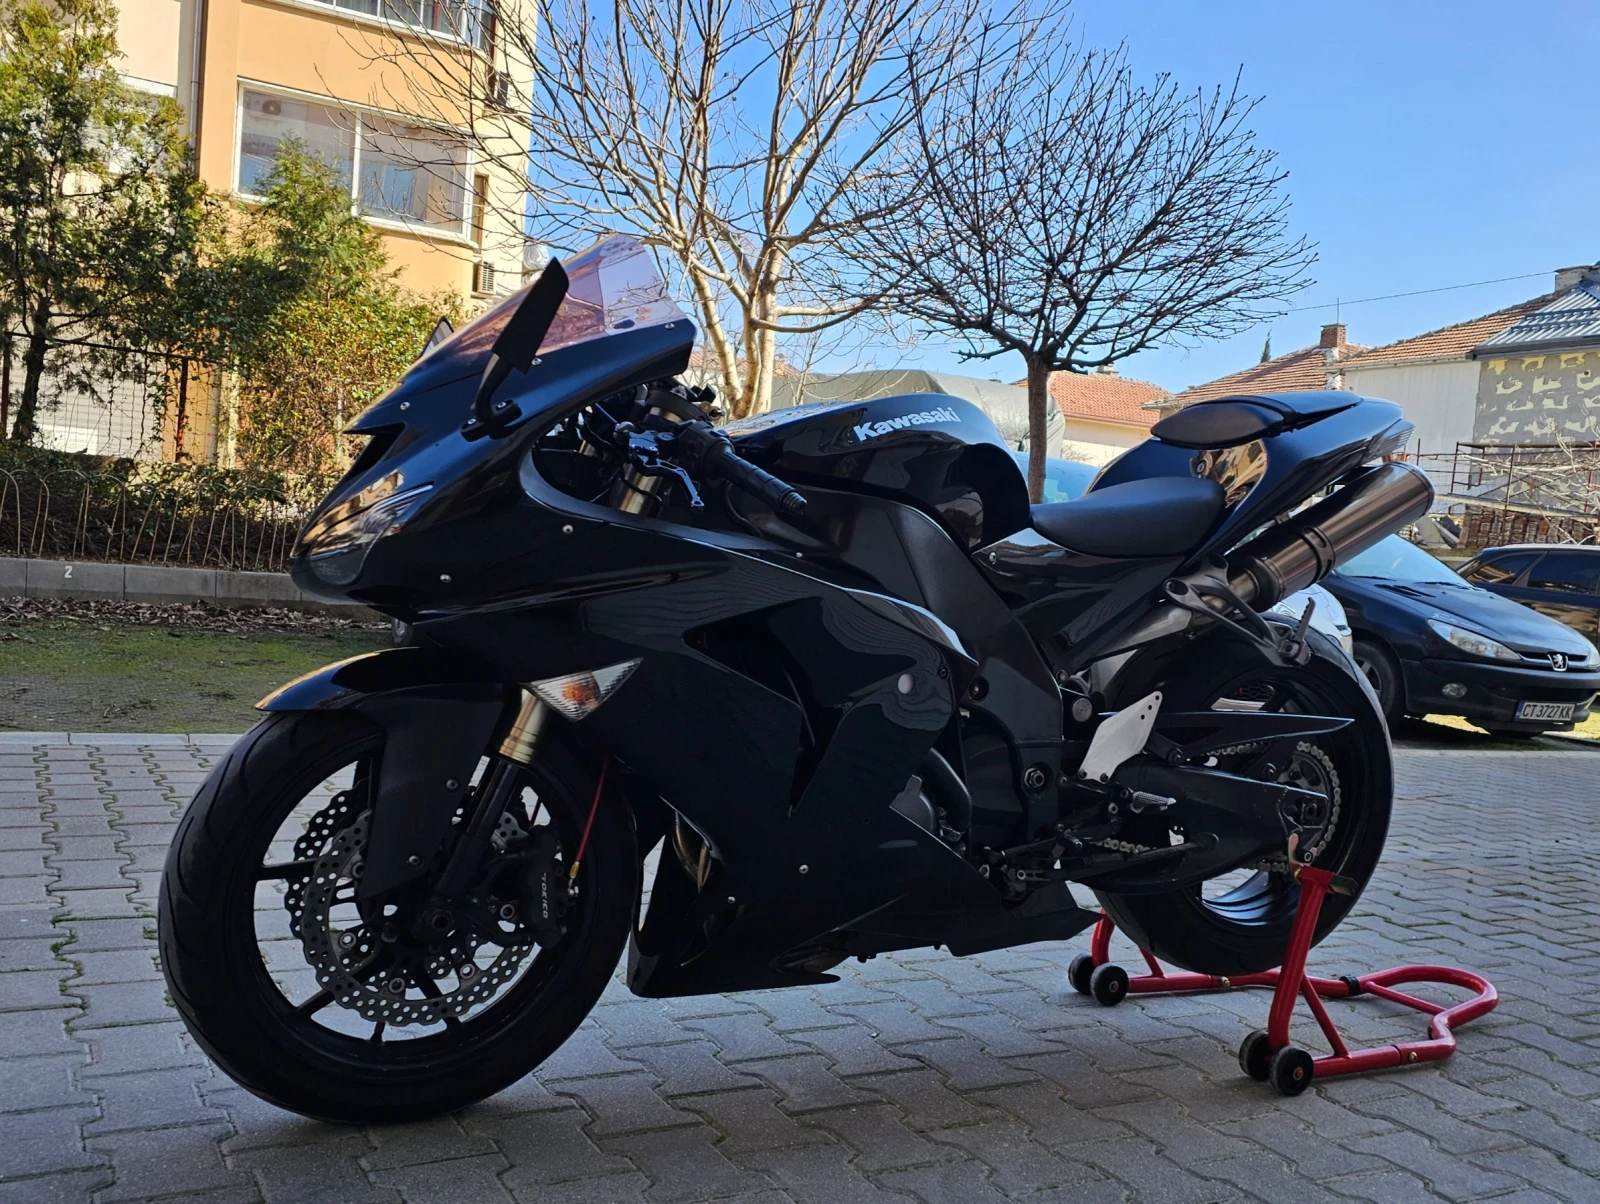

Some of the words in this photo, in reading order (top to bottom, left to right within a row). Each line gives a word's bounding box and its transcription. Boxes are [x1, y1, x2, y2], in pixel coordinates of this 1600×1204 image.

[853, 407, 961, 441] Kawasaki
[64, 565, 73, 578] 2
[541, 872, 549, 919] TOKICO
